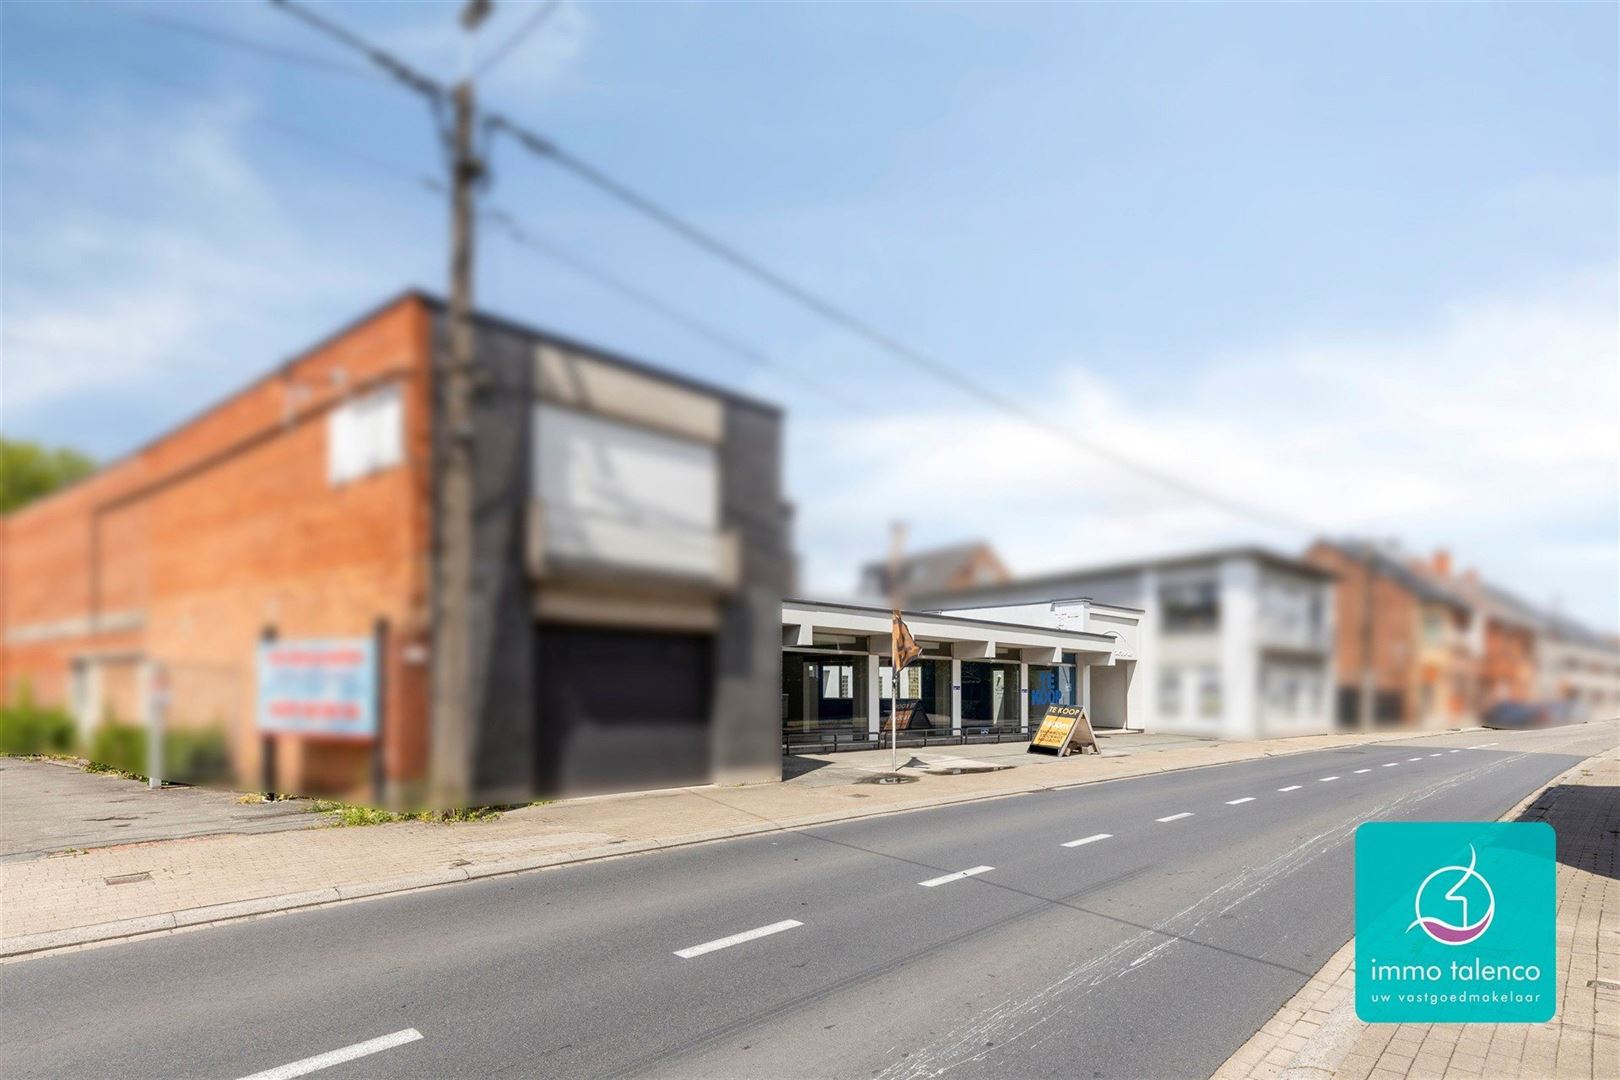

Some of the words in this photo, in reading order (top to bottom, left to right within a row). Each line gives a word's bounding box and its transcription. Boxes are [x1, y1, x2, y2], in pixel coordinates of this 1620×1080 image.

[1039, 672, 1055, 689] TE
[1031, 690, 1062, 705] KOOP
[1057, 707, 1080, 715] KOOP
